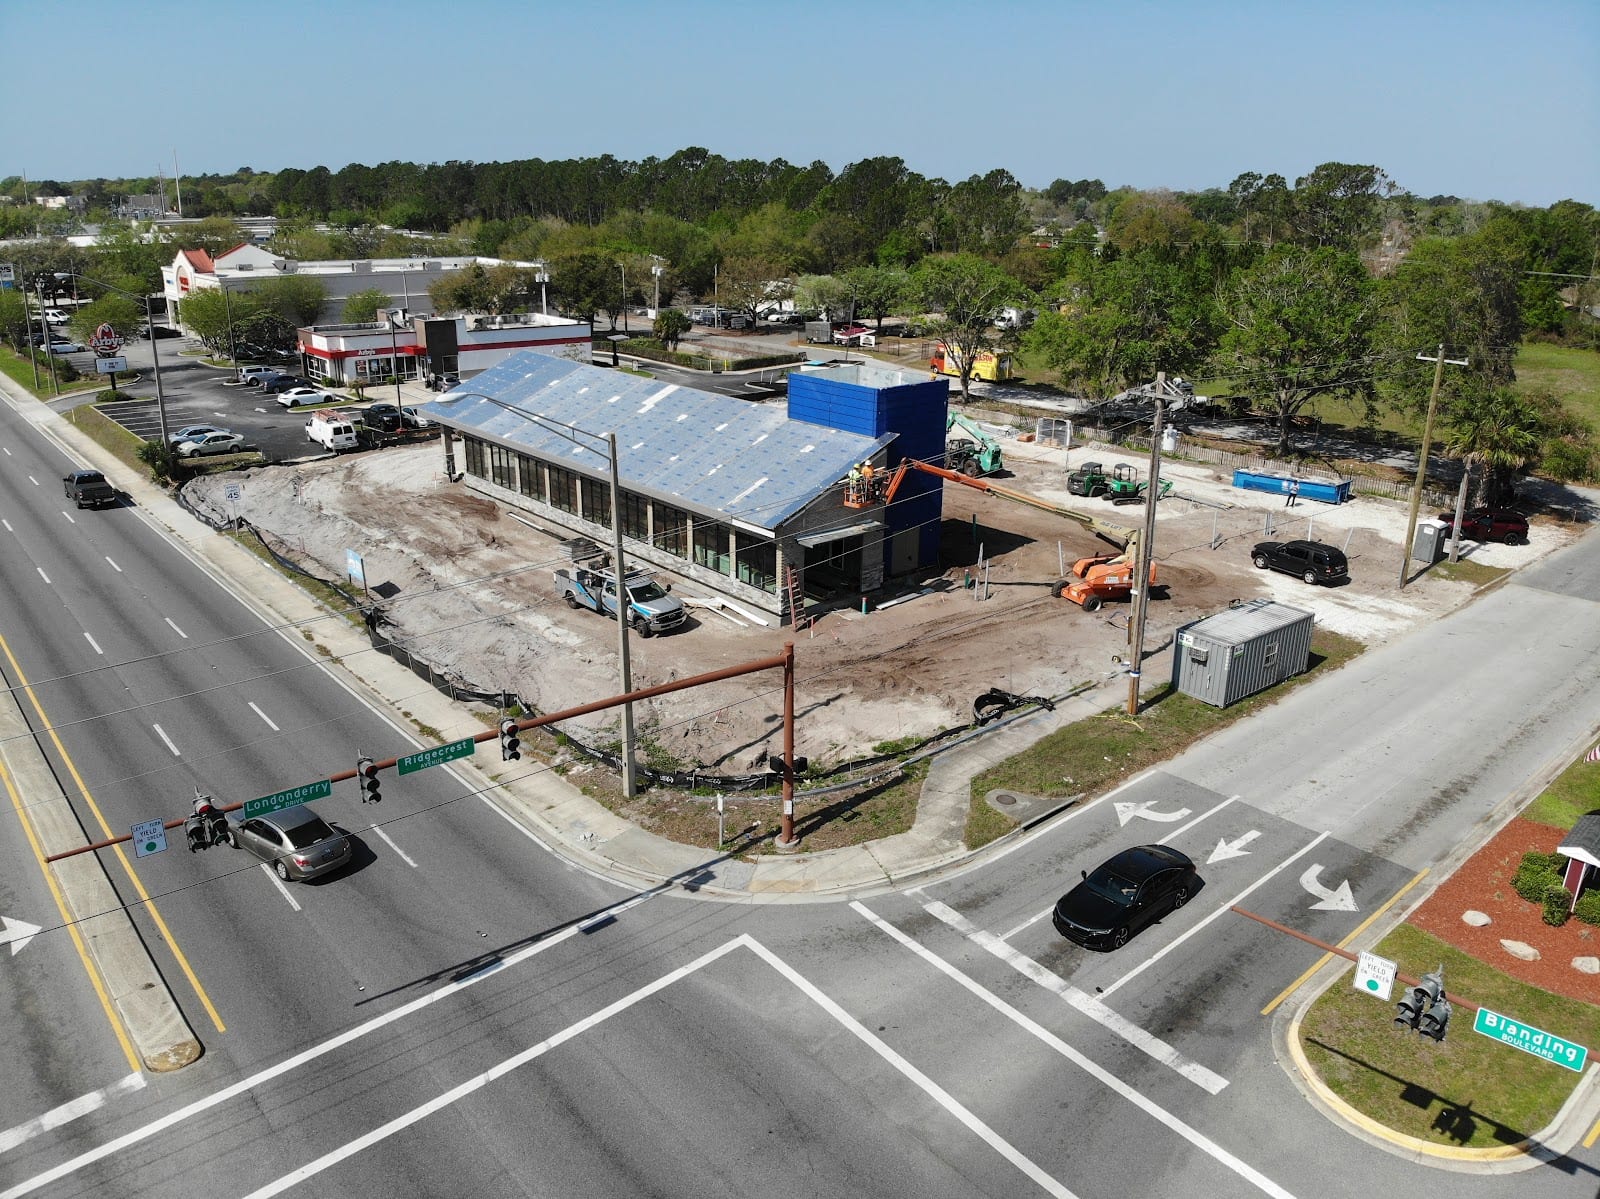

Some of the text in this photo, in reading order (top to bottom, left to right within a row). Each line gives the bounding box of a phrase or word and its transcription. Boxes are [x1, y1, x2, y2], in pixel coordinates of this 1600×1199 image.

[92, 335, 125, 347] Arby's
[404, 741, 467, 766] Ridgecrest
[420, 757, 443, 769] AVENUE
[246, 782, 329, 812] Londonderry
[285, 797, 304, 807] DRIVE
[140, 828, 157, 837] YIELD
[1367, 962, 1386, 975] YIELD
[1485, 1012, 1577, 1062] Blanding
[1501, 1032, 1554, 1059] BOULEVARD
